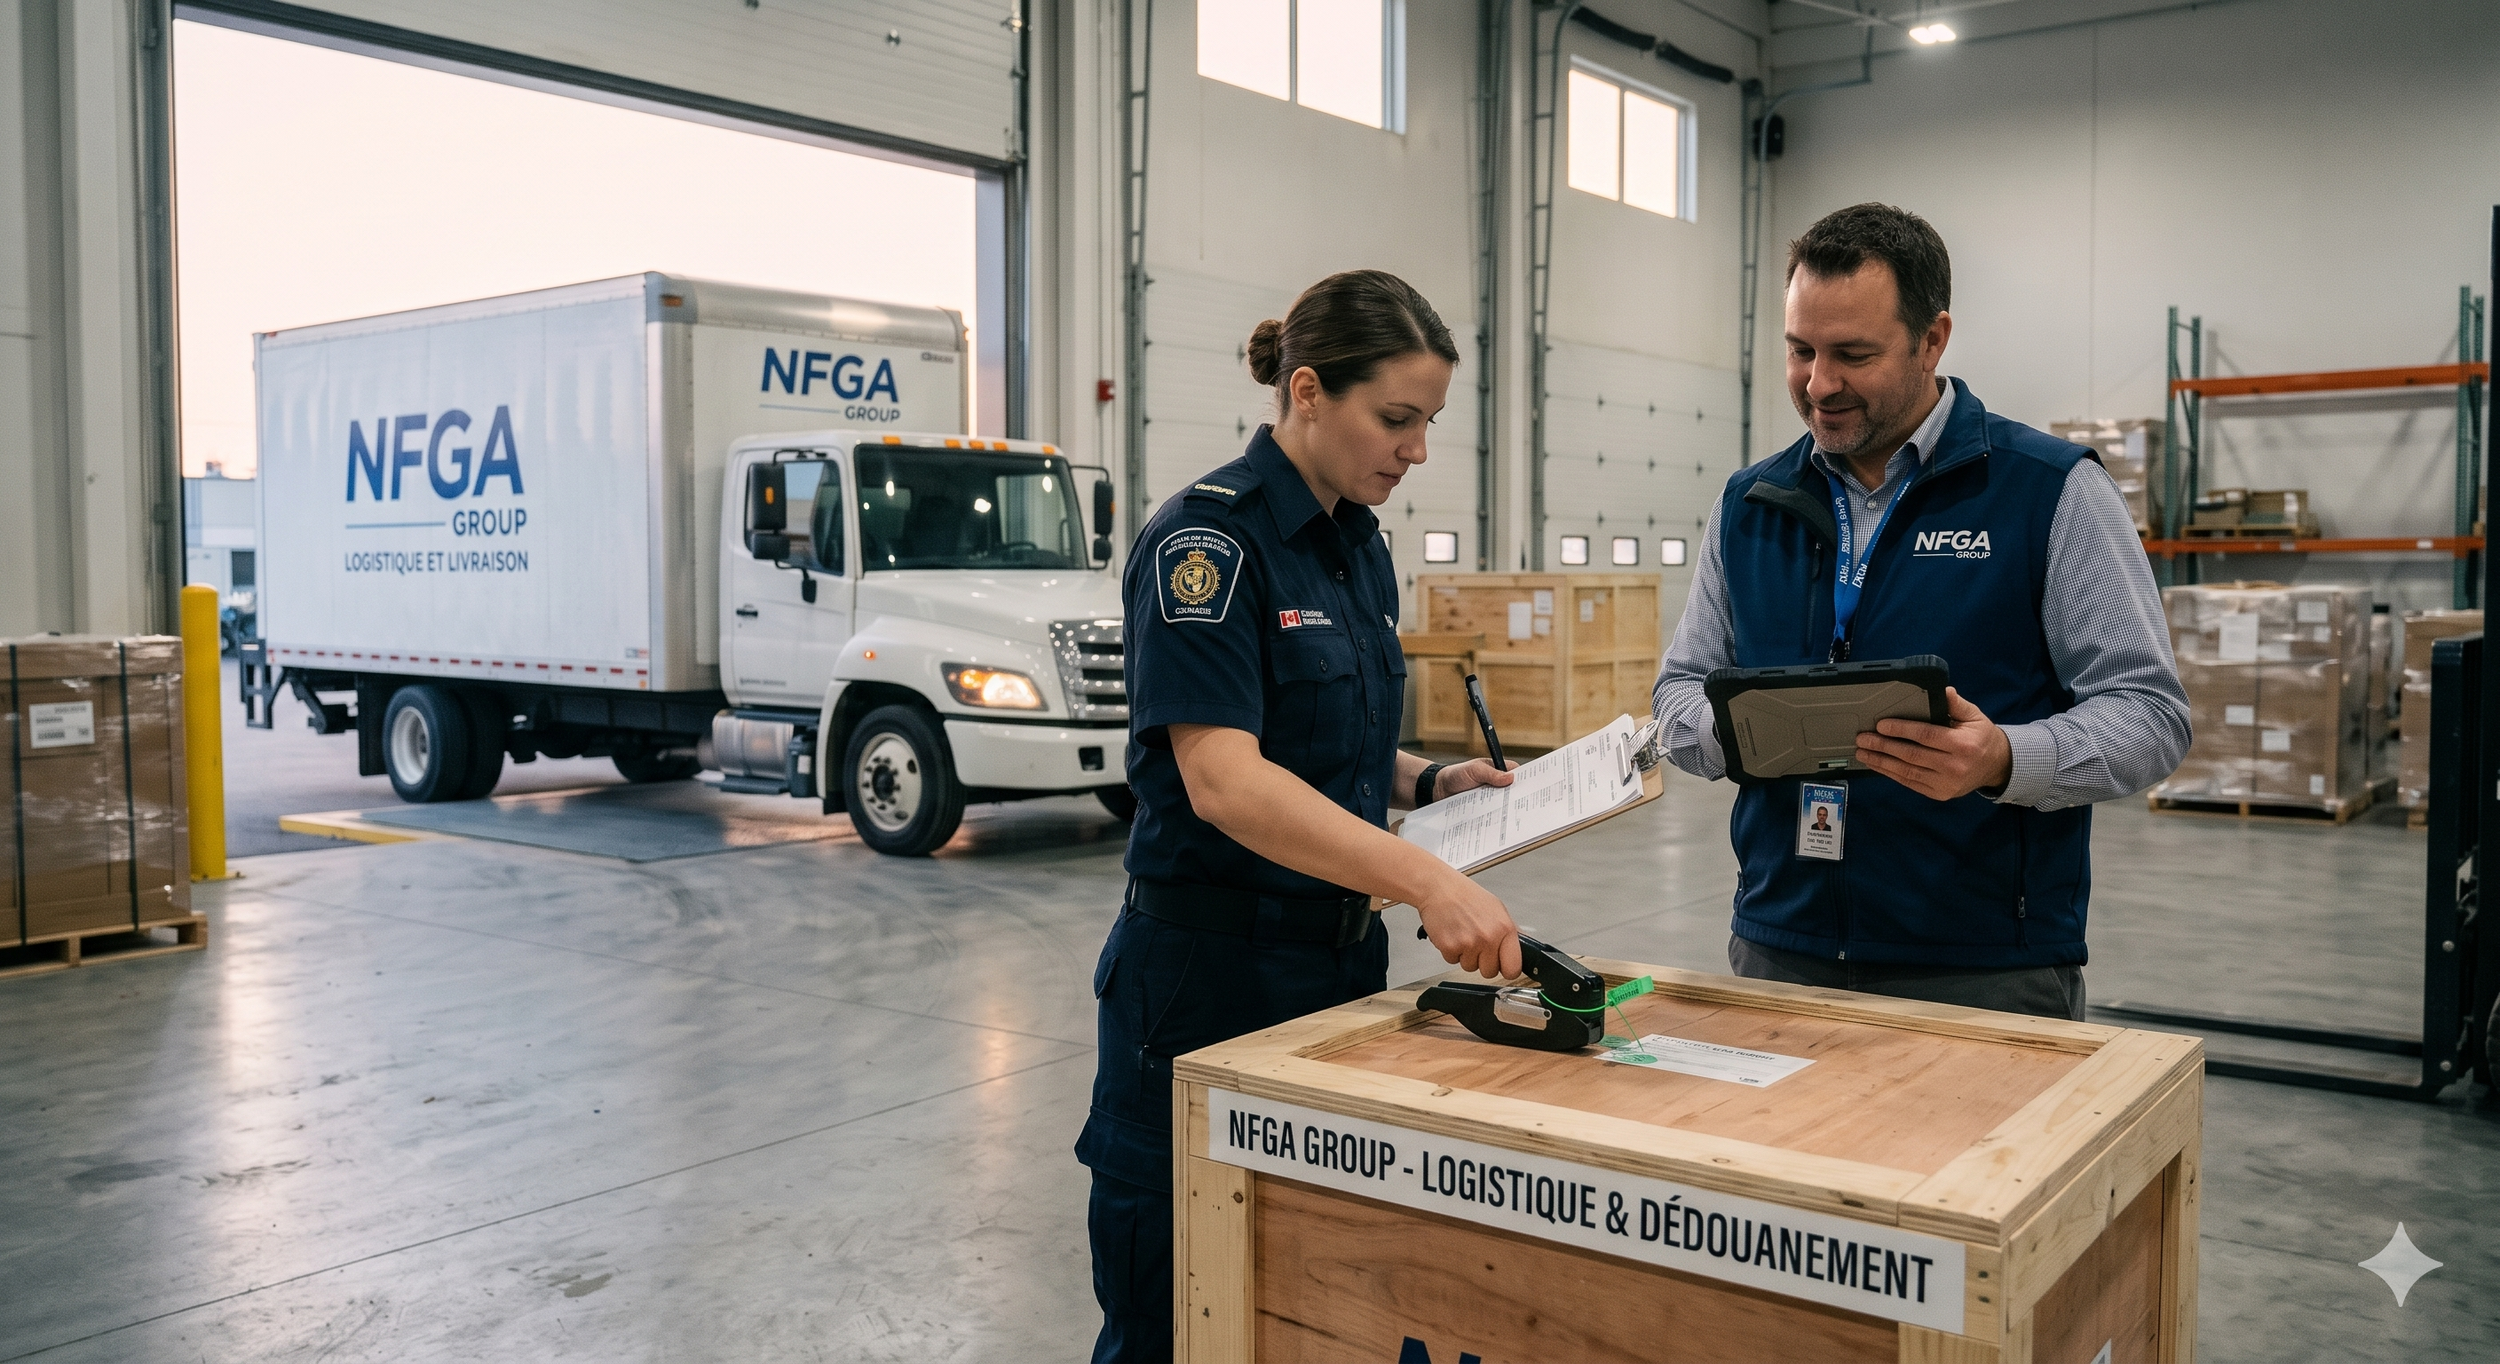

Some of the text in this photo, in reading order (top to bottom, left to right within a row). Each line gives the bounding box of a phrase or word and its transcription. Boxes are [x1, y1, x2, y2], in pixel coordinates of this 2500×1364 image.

[760, 347, 899, 403] NFGA
[845, 405, 900, 423] GROUP
[346, 405, 525, 502] NFGA
[452, 508, 527, 537] GROUP
[1914, 530, 1991, 551] NFGA
[345, 551, 529, 575] LOGISTIQUE ET LIVRAISON
[1955, 550, 1991, 559] GROUP
[1229, 1109, 1934, 1305] NFGA GROUP - LOGISTIQUE & DÉDOUANEMENT
